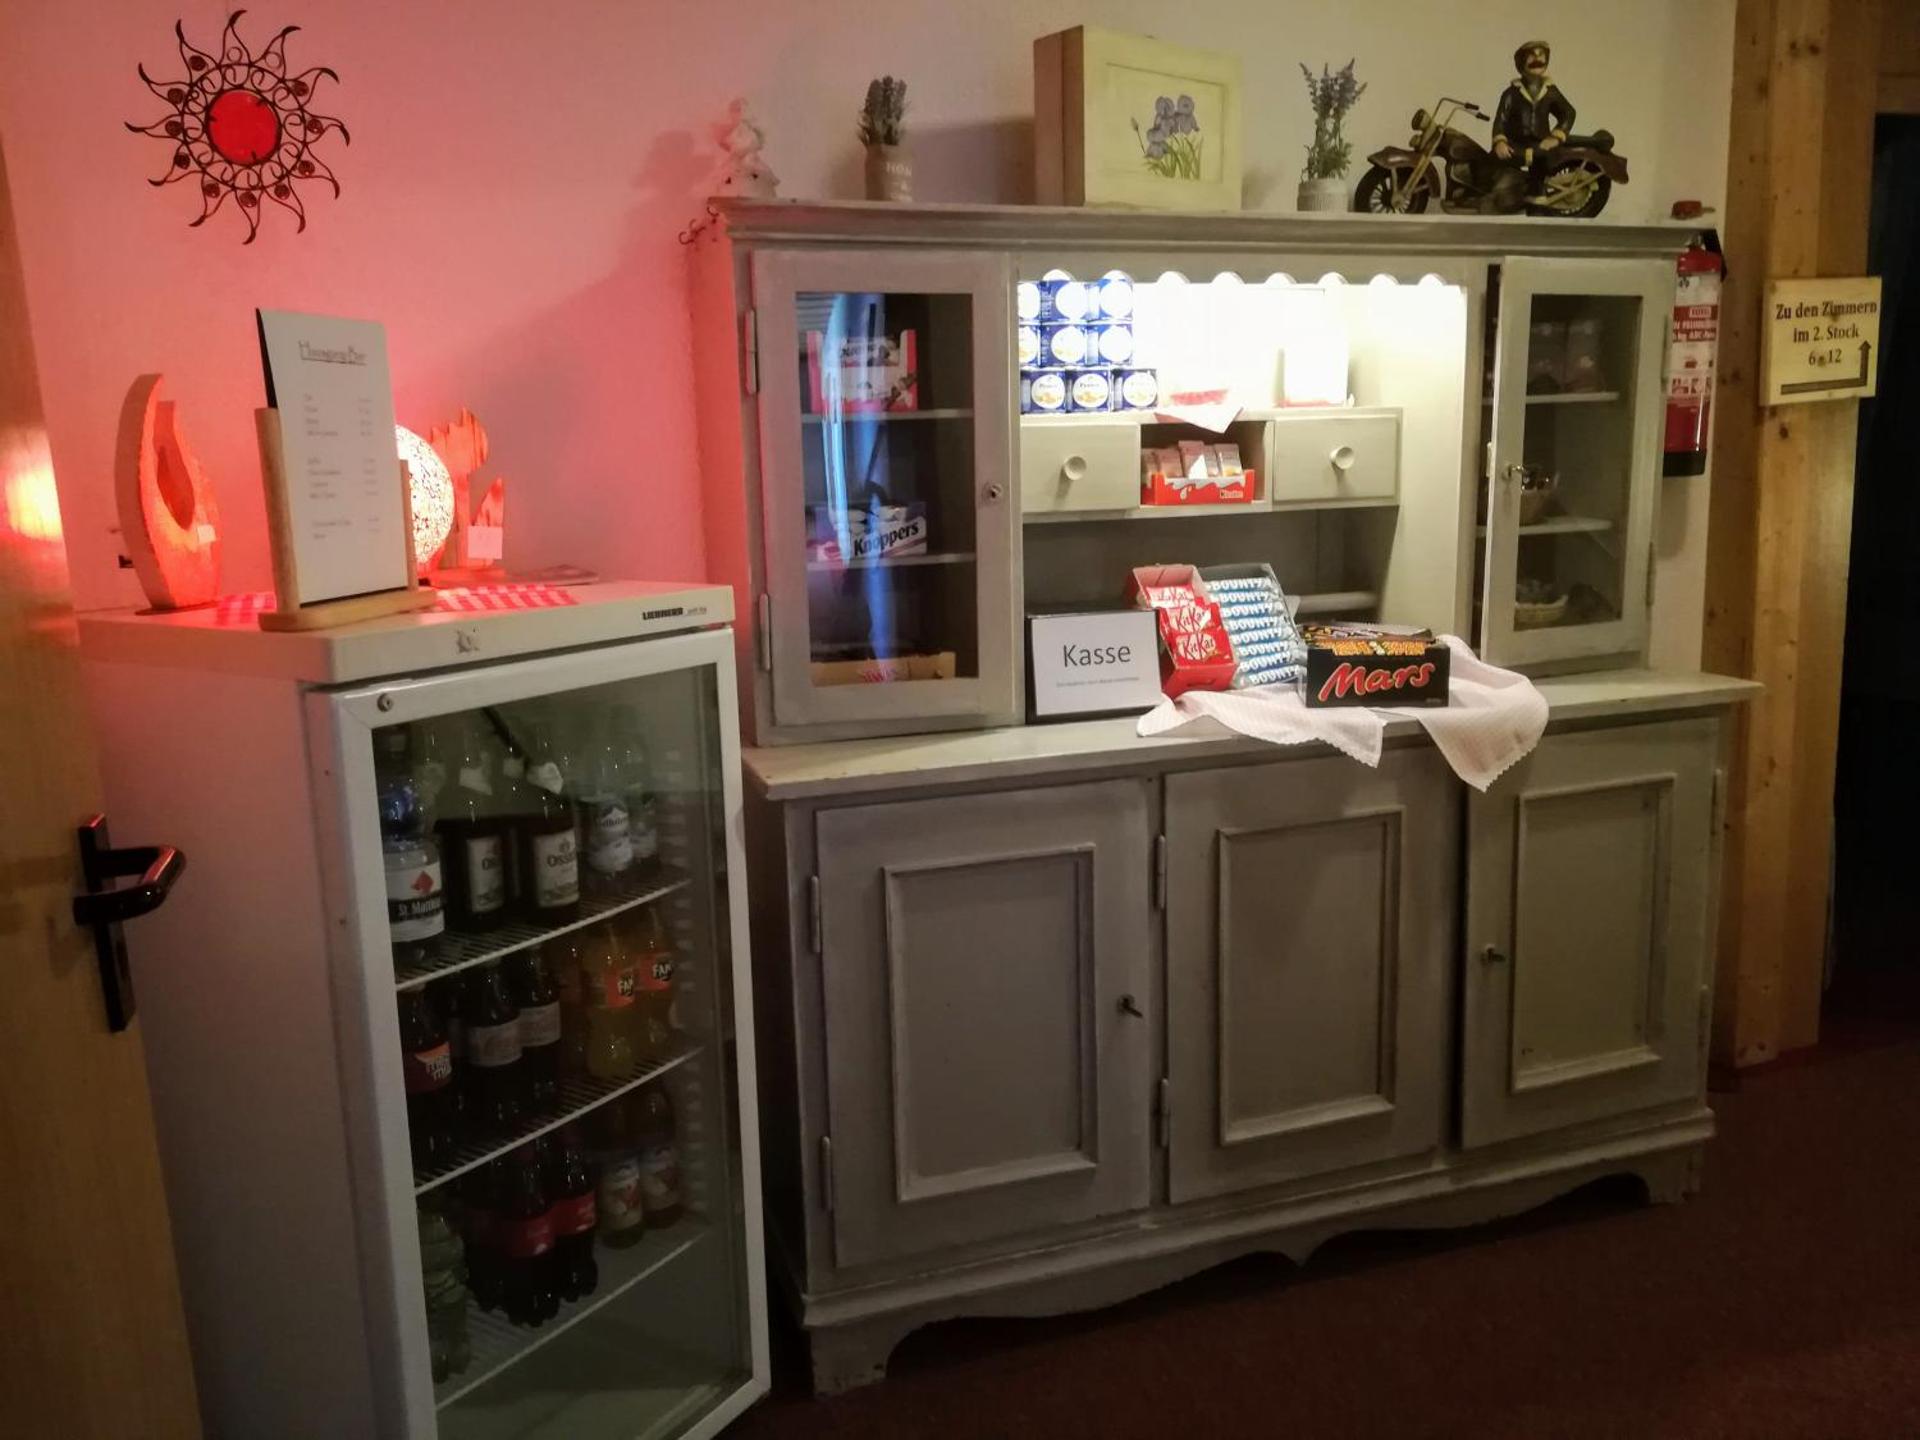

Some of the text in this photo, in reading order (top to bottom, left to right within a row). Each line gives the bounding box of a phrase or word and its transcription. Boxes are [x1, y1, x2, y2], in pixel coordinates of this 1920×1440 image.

[1775, 301, 1878, 320] Zu den Zimmern
[1827, 323, 1859, 340] Stock
[1808, 350, 1816, 366] 6
[1828, 348, 1842, 363] 12
[854, 521, 919, 557] Knoppers
[1212, 579, 1266, 591] BOUNTY
[1219, 590, 1269, 603] BOUNTY
[1221, 602, 1273, 618] BOUNTY
[1228, 617, 1278, 631] BOUNTY
[1231, 628, 1281, 646] BOUNTY
[1181, 632, 1214, 661] KitKat
[1239, 641, 1289, 657] BOUNTY
[1063, 645, 1131, 668] Kasse
[1240, 651, 1290, 673] BOUNTY
[1249, 666, 1300, 685] BOUNTY
[1318, 662, 1436, 702] Mars
